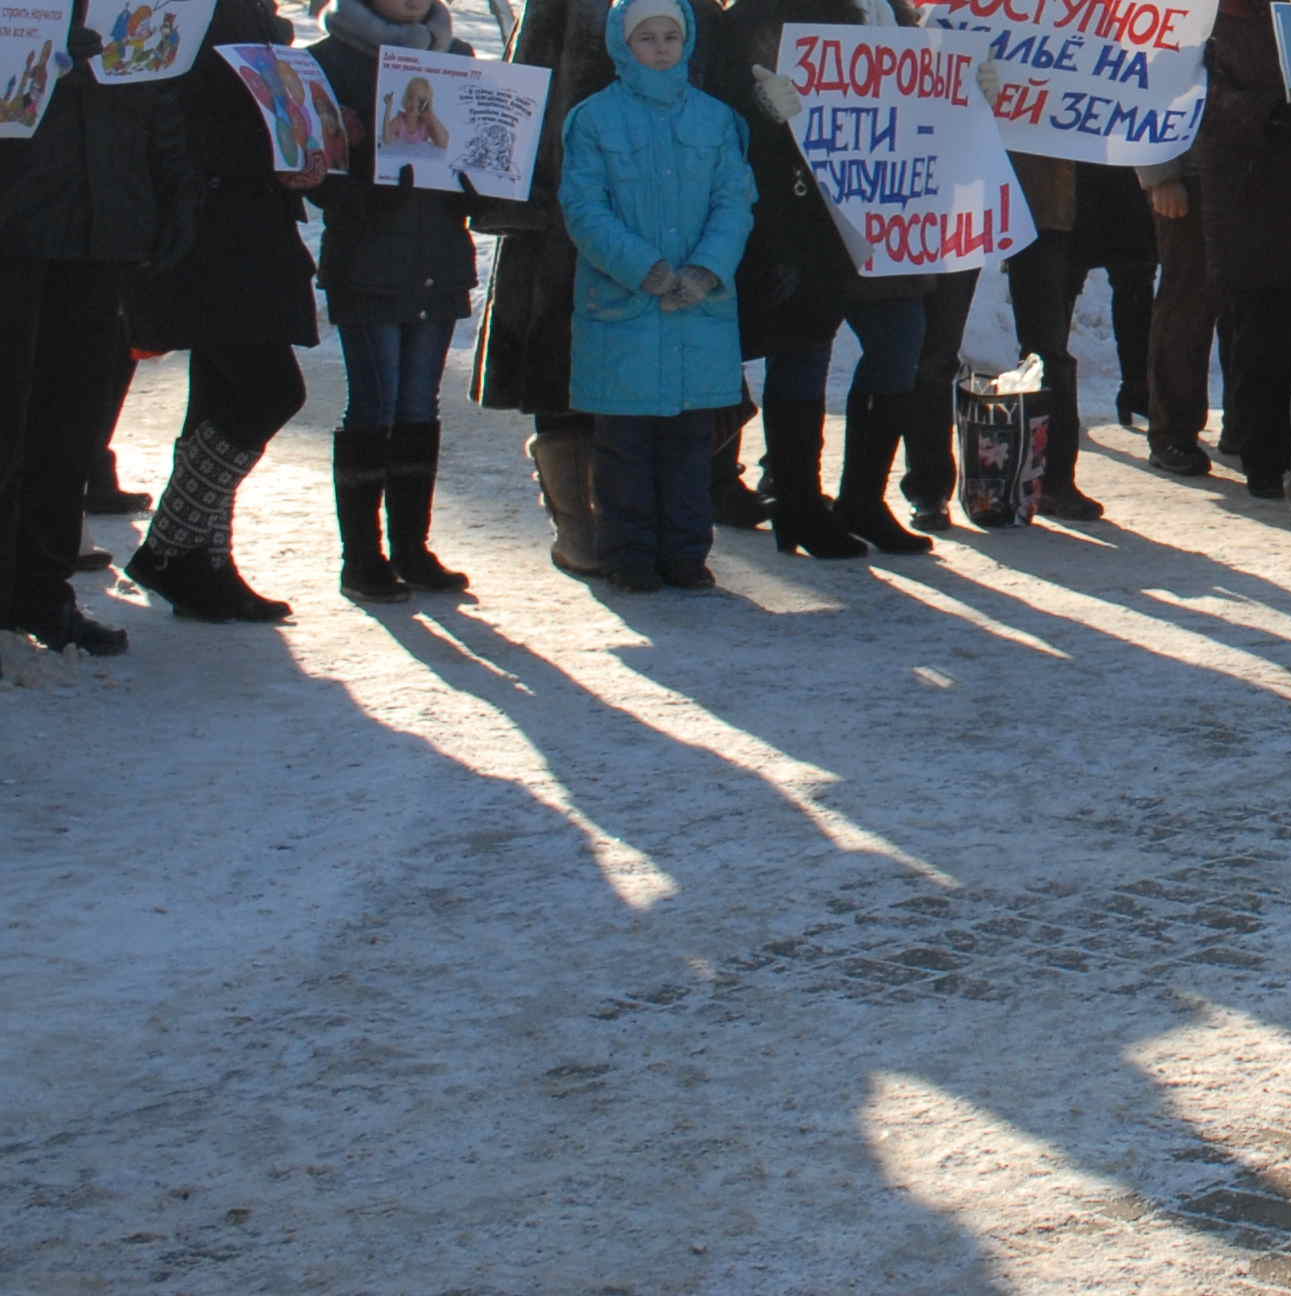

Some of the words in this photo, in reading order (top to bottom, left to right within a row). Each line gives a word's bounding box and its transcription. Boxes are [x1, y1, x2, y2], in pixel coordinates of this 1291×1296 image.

[791, 36, 972, 107] ЗДОРОВЫЕ
[1092, 45, 1149, 89] НА
[803, 106, 897, 157] ДЕТИ
[1050, 92, 1206, 144] ЗЕМЛЕ!
[865, 183, 1014, 272] РОССИИ!
